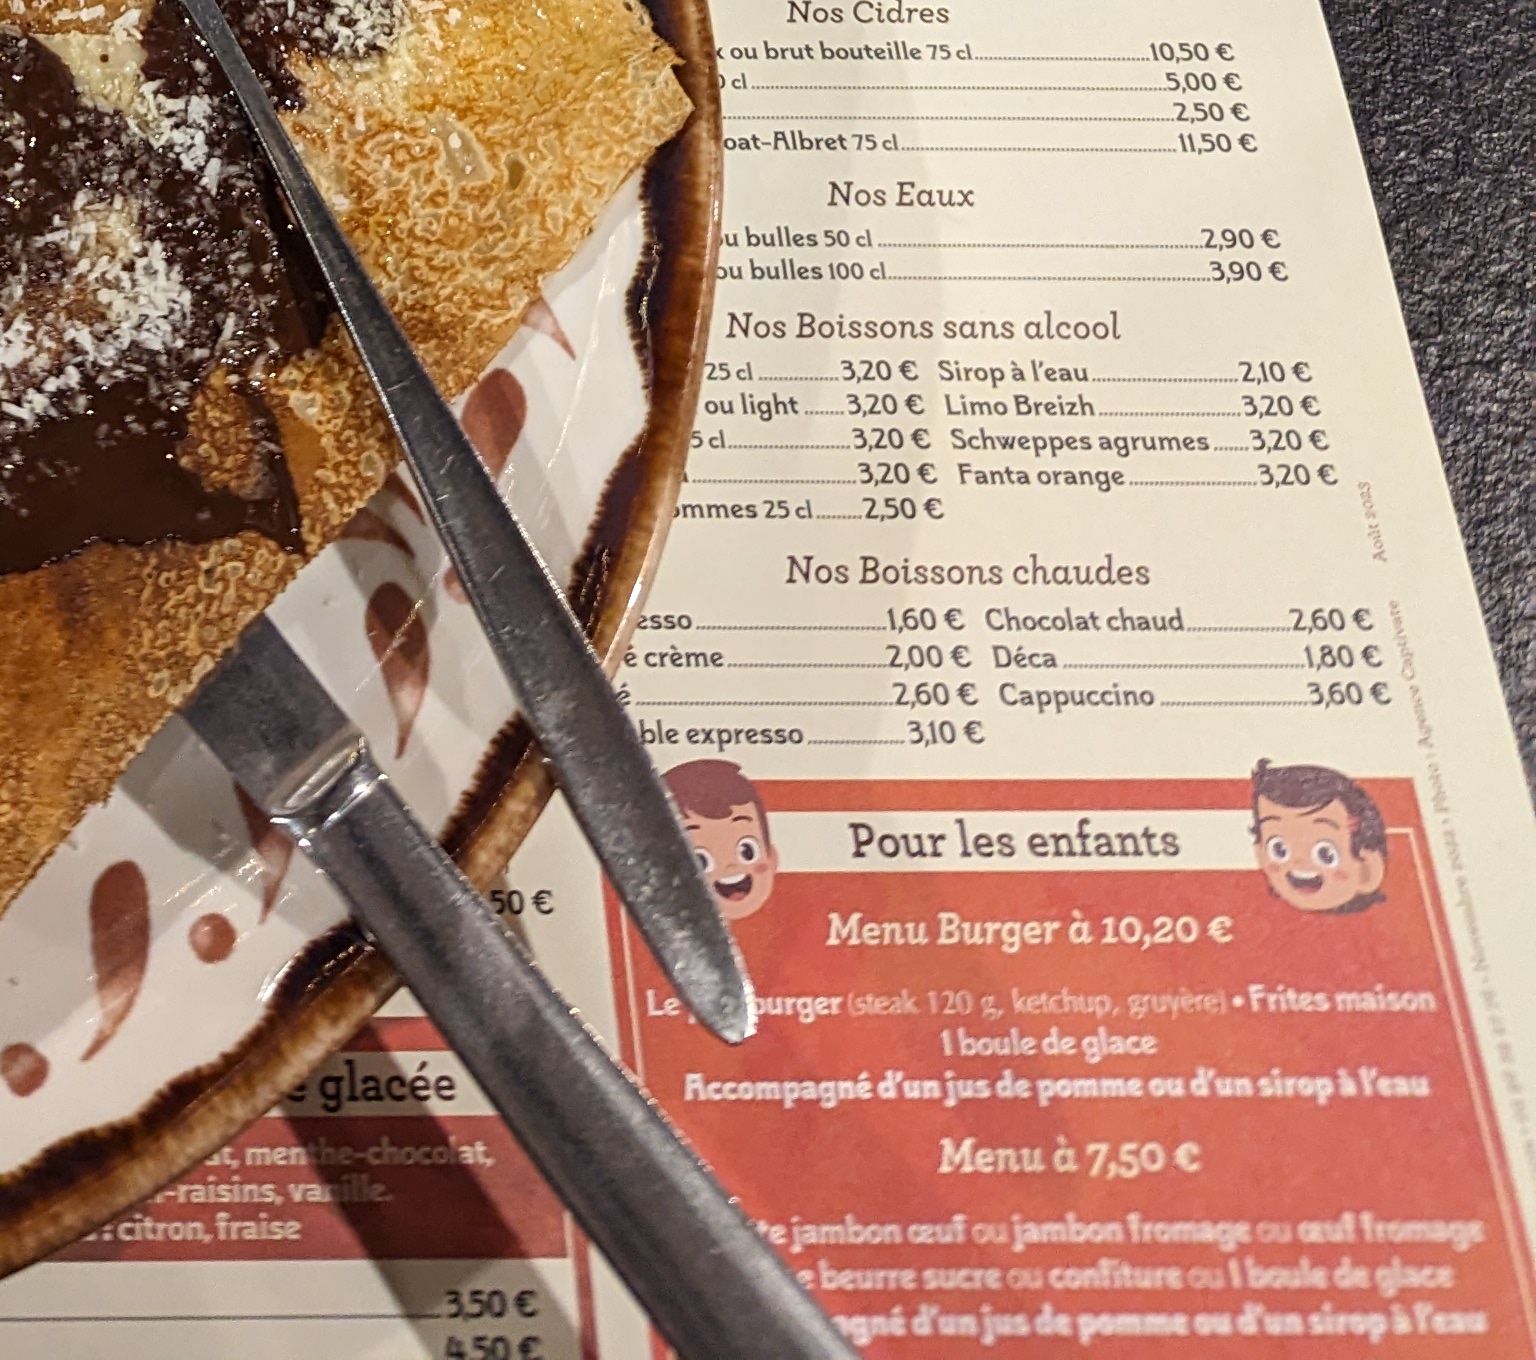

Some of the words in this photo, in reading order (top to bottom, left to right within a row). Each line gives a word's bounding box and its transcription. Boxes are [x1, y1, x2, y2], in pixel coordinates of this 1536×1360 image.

[786, 0, 844, 24] Nos
[826, 180, 887, 208] Nos
[895, 181, 975, 208] Eaux
[725, 312, 787, 339] Nos
[795, 312, 934, 340] Boissons
[942, 320, 1015, 340] sans
[1023, 310, 1122, 340] alcool
[937, 359, 1006, 389] Sirop
[1010, 360, 1026, 382] à
[1030, 358, 1089, 382] l'eau
[1238, 361, 1286, 383] 2,10
[1291, 361, 1313, 383] €
[944, 393, 1008, 416] Limo
[1012, 393, 1096, 416] Breizh
[1241, 394, 1294, 417] 3,20
[1299, 394, 1322, 417] €
[957, 462, 1032, 486] Fanta
[1036, 470, 1126, 493] orange
[1257, 463, 1311, 486] 3,20
[1316, 463, 1339, 486] €
[785, 554, 850, 584] Nos
[858, 555, 1003, 586] Boissons
[1012, 552, 1150, 586] chaudes
[998, 682, 1155, 714] Cappuccino
[1306, 681, 1363, 710] 3,60
[1369, 681, 1392, 706] €
[848, 822, 947, 859] Pour
[954, 818, 1016, 858] les
[1027, 816, 1180, 858] enfants
[825, 912, 929, 946] Menu
[936, 909, 1062, 954] Burger
[1068, 908, 1094, 945] à
[1100, 915, 1200, 952] 10,20
[1206, 915, 1234, 944] €
[940, 1029, 954, 1057] 1
[956, 1026, 1038, 1056] boule
[1041, 1025, 1078, 1056] de
[1081, 1026, 1159, 1064] glace
[320, 1060, 457, 1113] glacée
[684, 1070, 874, 1110] Accompagné
[876, 1069, 943, 1100] d'un
[943, 1069, 992, 1108] jus
[994, 1068, 1033, 1099] de
[1035, 1077, 1144, 1108] pomme
[1148, 1076, 1186, 1098] ou
[1189, 1066, 1255, 1098] d'un
[1256, 1067, 1335, 1106] sirop
[1336, 1067, 1358, 1098] à
[1357, 1065, 1431, 1098] l'eau
[936, 1136, 1046, 1174] Menu
[1052, 1134, 1079, 1173] à
[1085, 1141, 1166, 1180] 7,50
[1172, 1141, 1201, 1173] €
